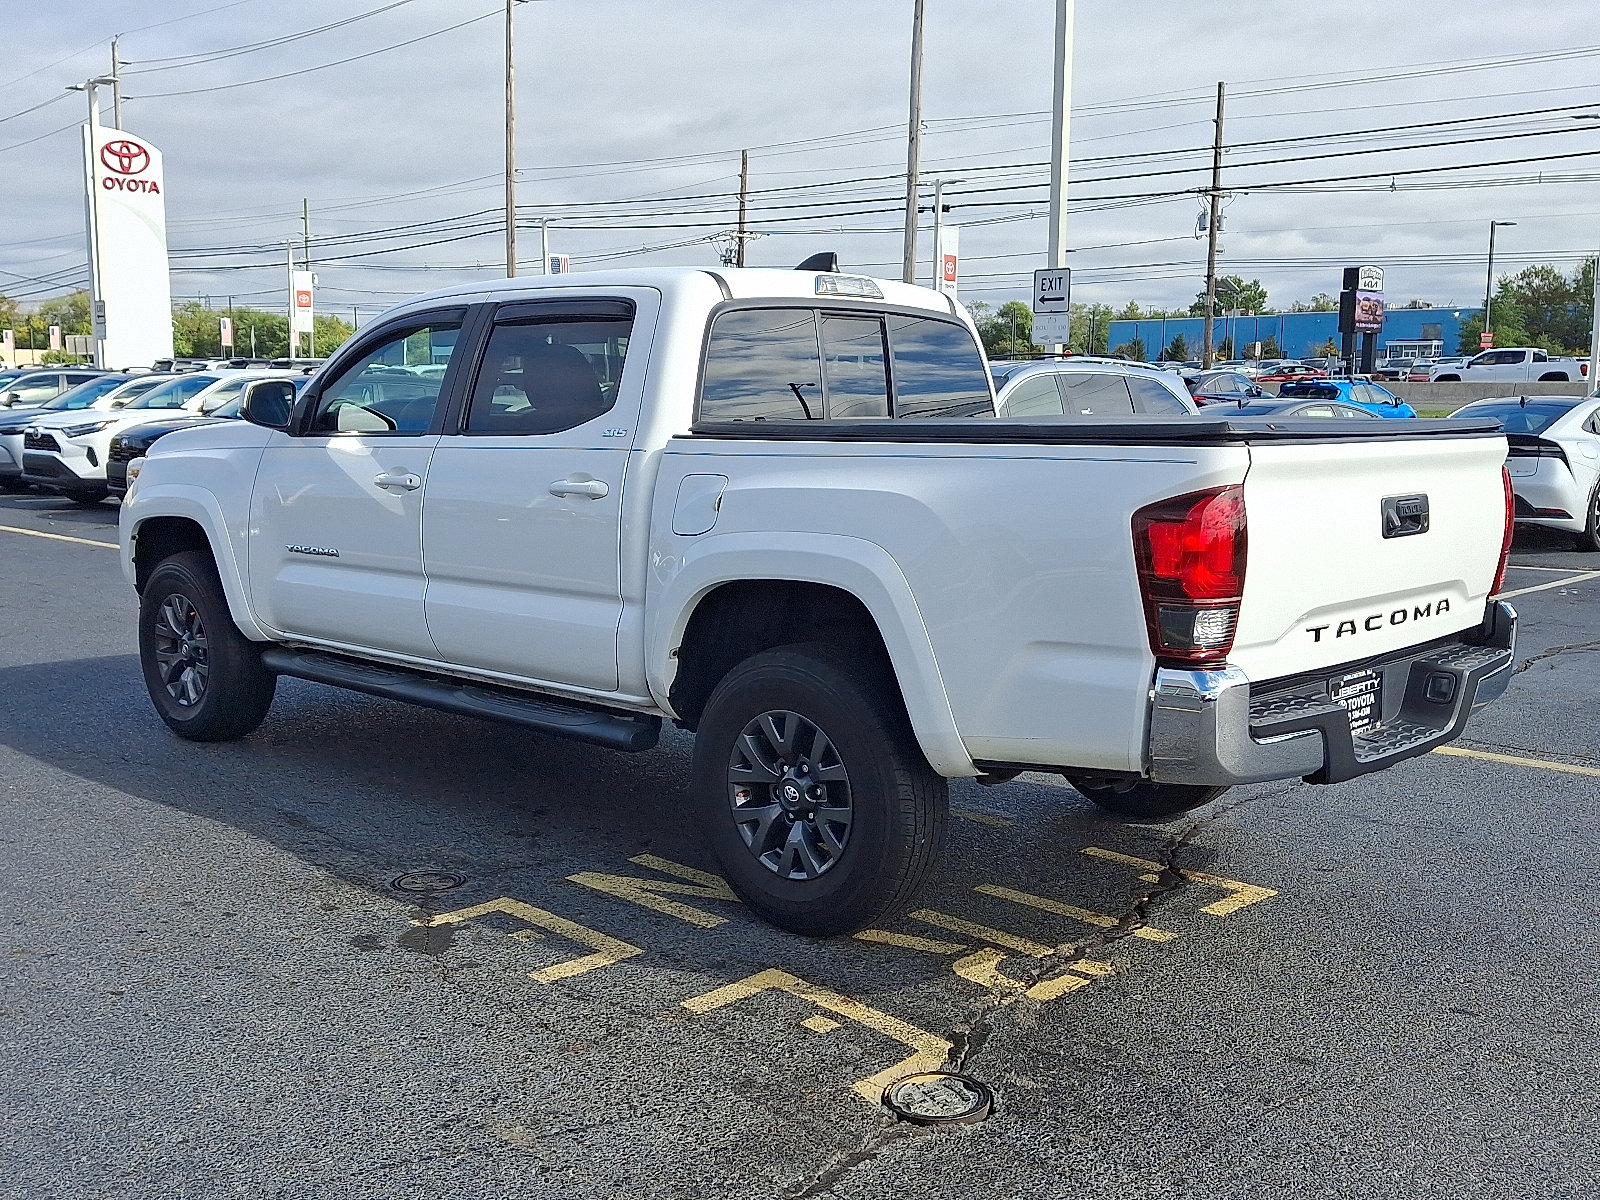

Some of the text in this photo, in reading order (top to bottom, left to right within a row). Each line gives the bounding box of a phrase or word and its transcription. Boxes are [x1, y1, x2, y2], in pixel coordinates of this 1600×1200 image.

[102, 176, 160, 194] OYOTA
[1041, 277, 1063, 291] EXIT
[602, 428, 628, 437] SR5
[285, 544, 340, 557] TACOMA
[1305, 598, 1450, 643] TACOMA
[1331, 677, 1381, 700] LIBERTY
[1347, 692, 1375, 710] TOYOTA
